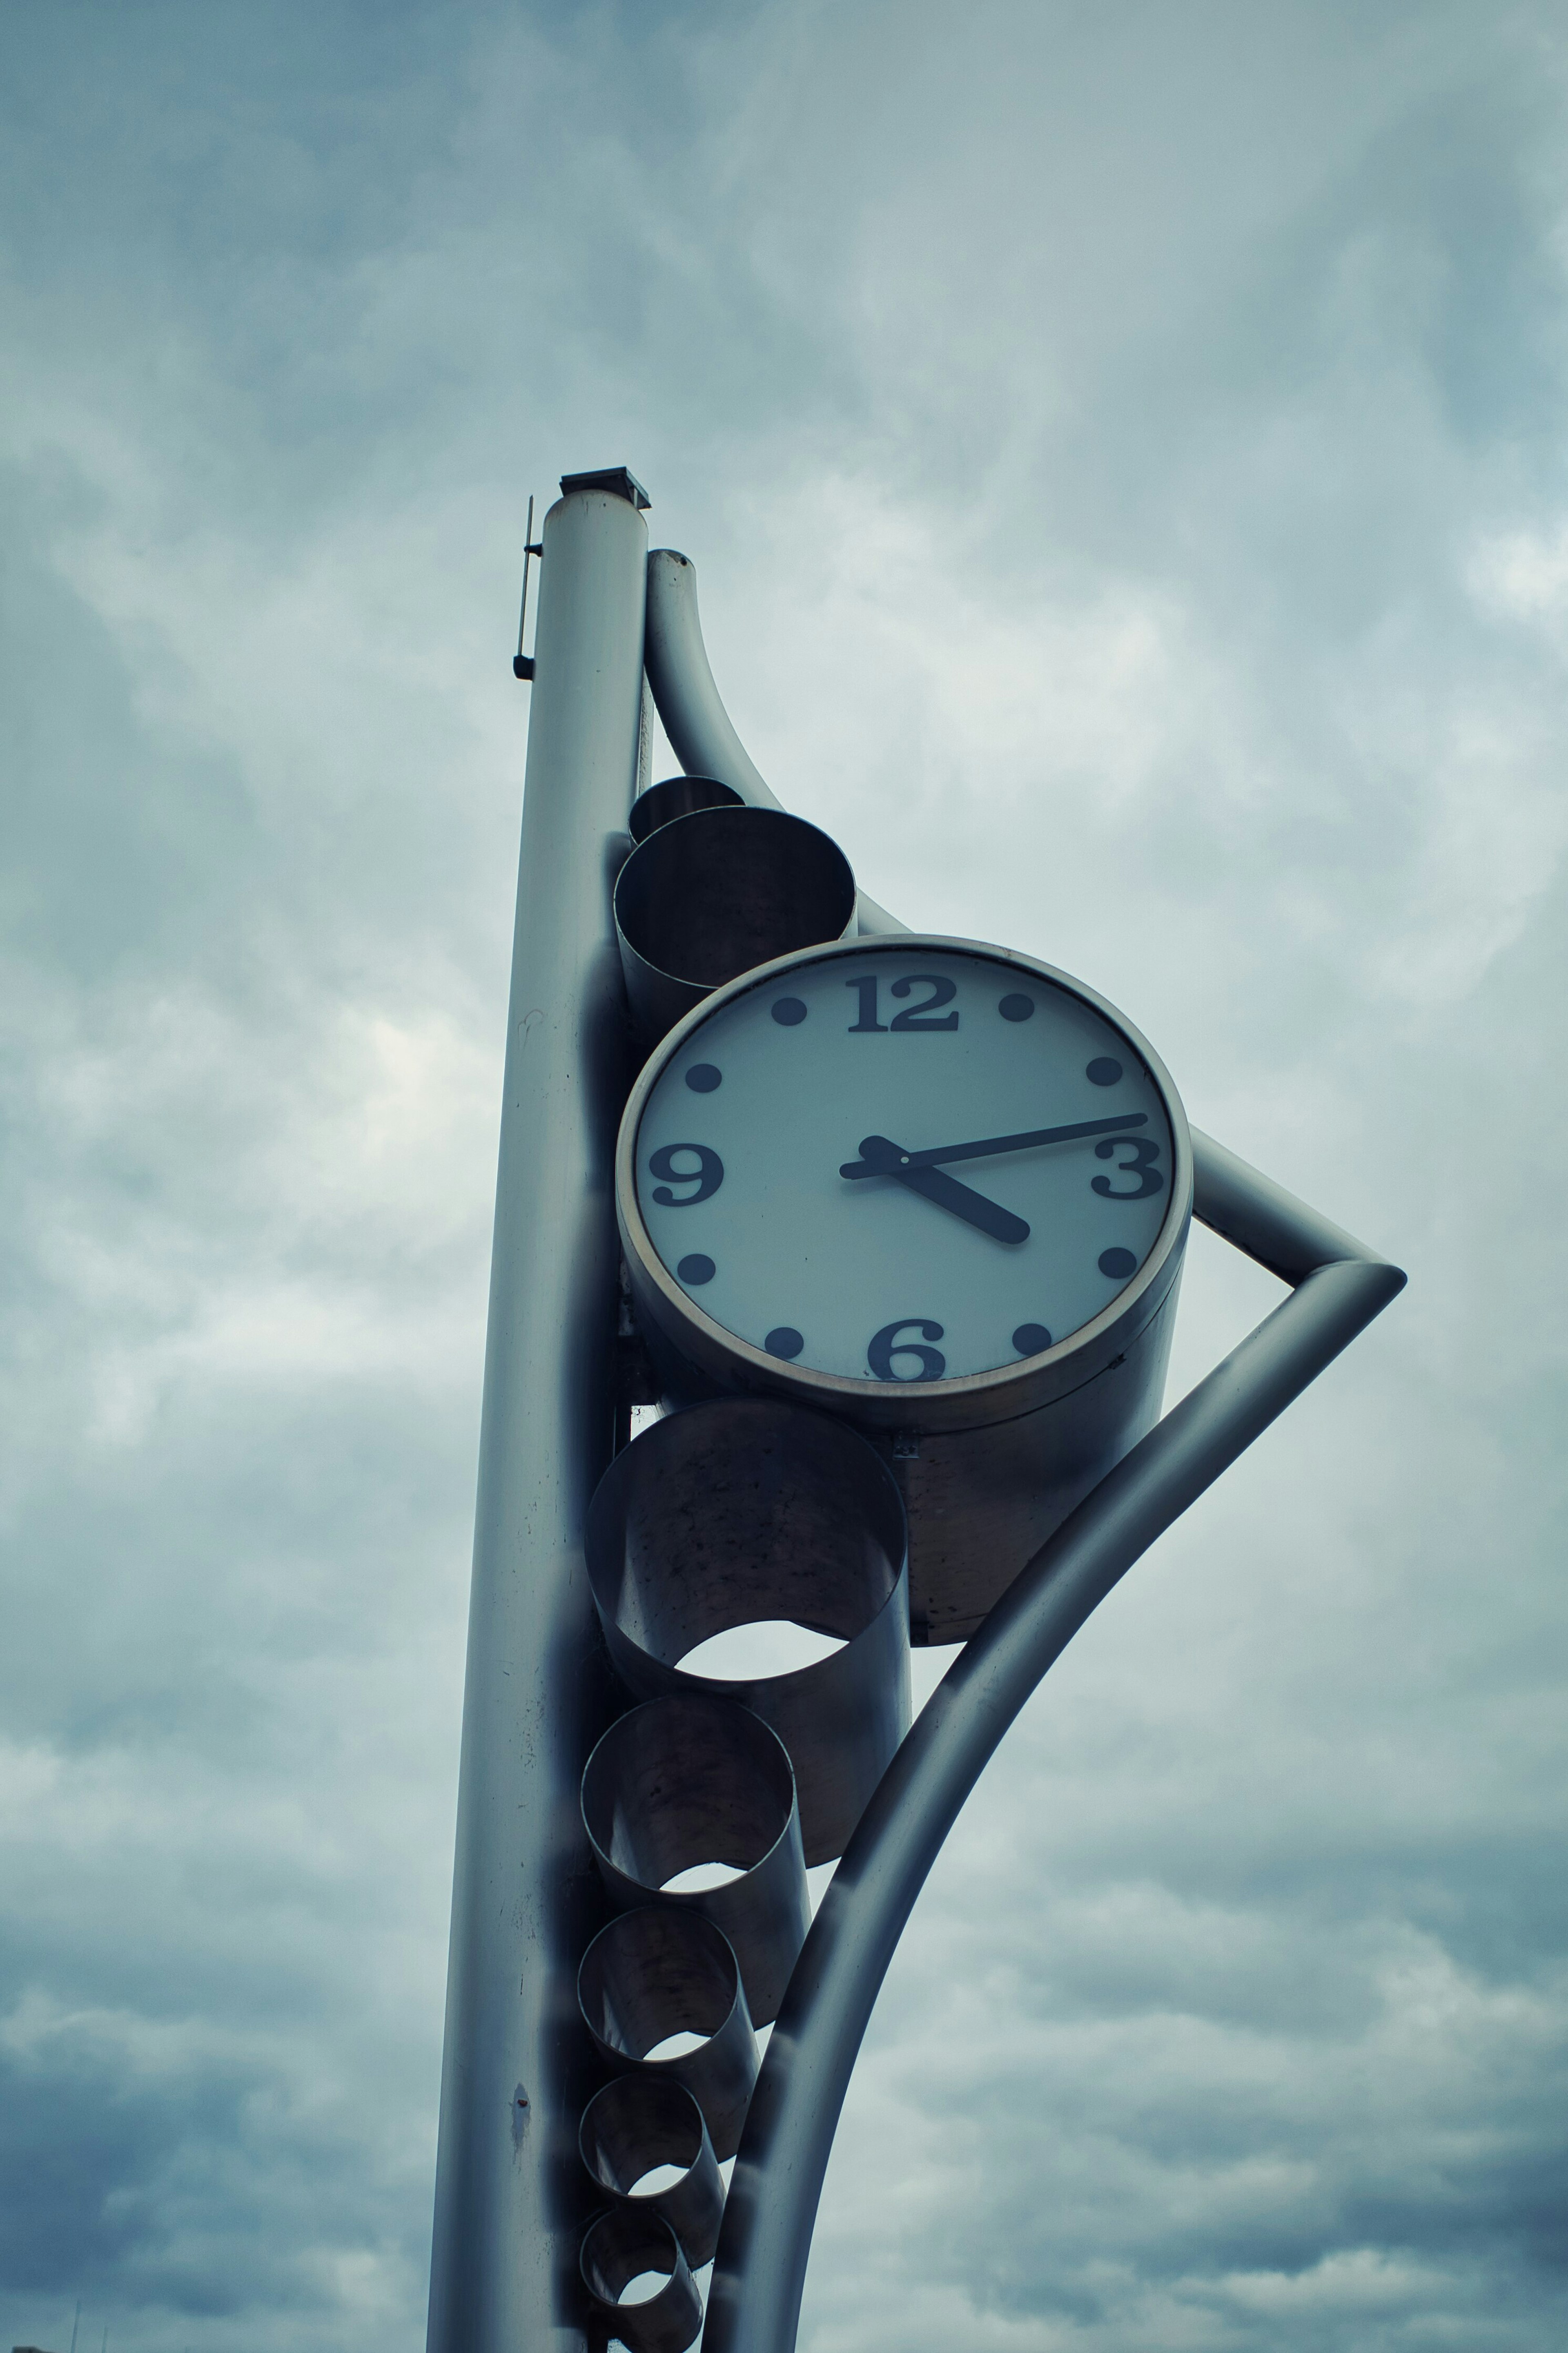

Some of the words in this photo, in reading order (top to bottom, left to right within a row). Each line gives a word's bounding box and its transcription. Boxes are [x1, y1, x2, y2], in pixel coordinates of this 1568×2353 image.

[846, 975, 959, 1033] 12
[649, 1143, 724, 1207] 9
[1091, 1137, 1164, 1200] 3
[867, 1318, 946, 1382] 6
